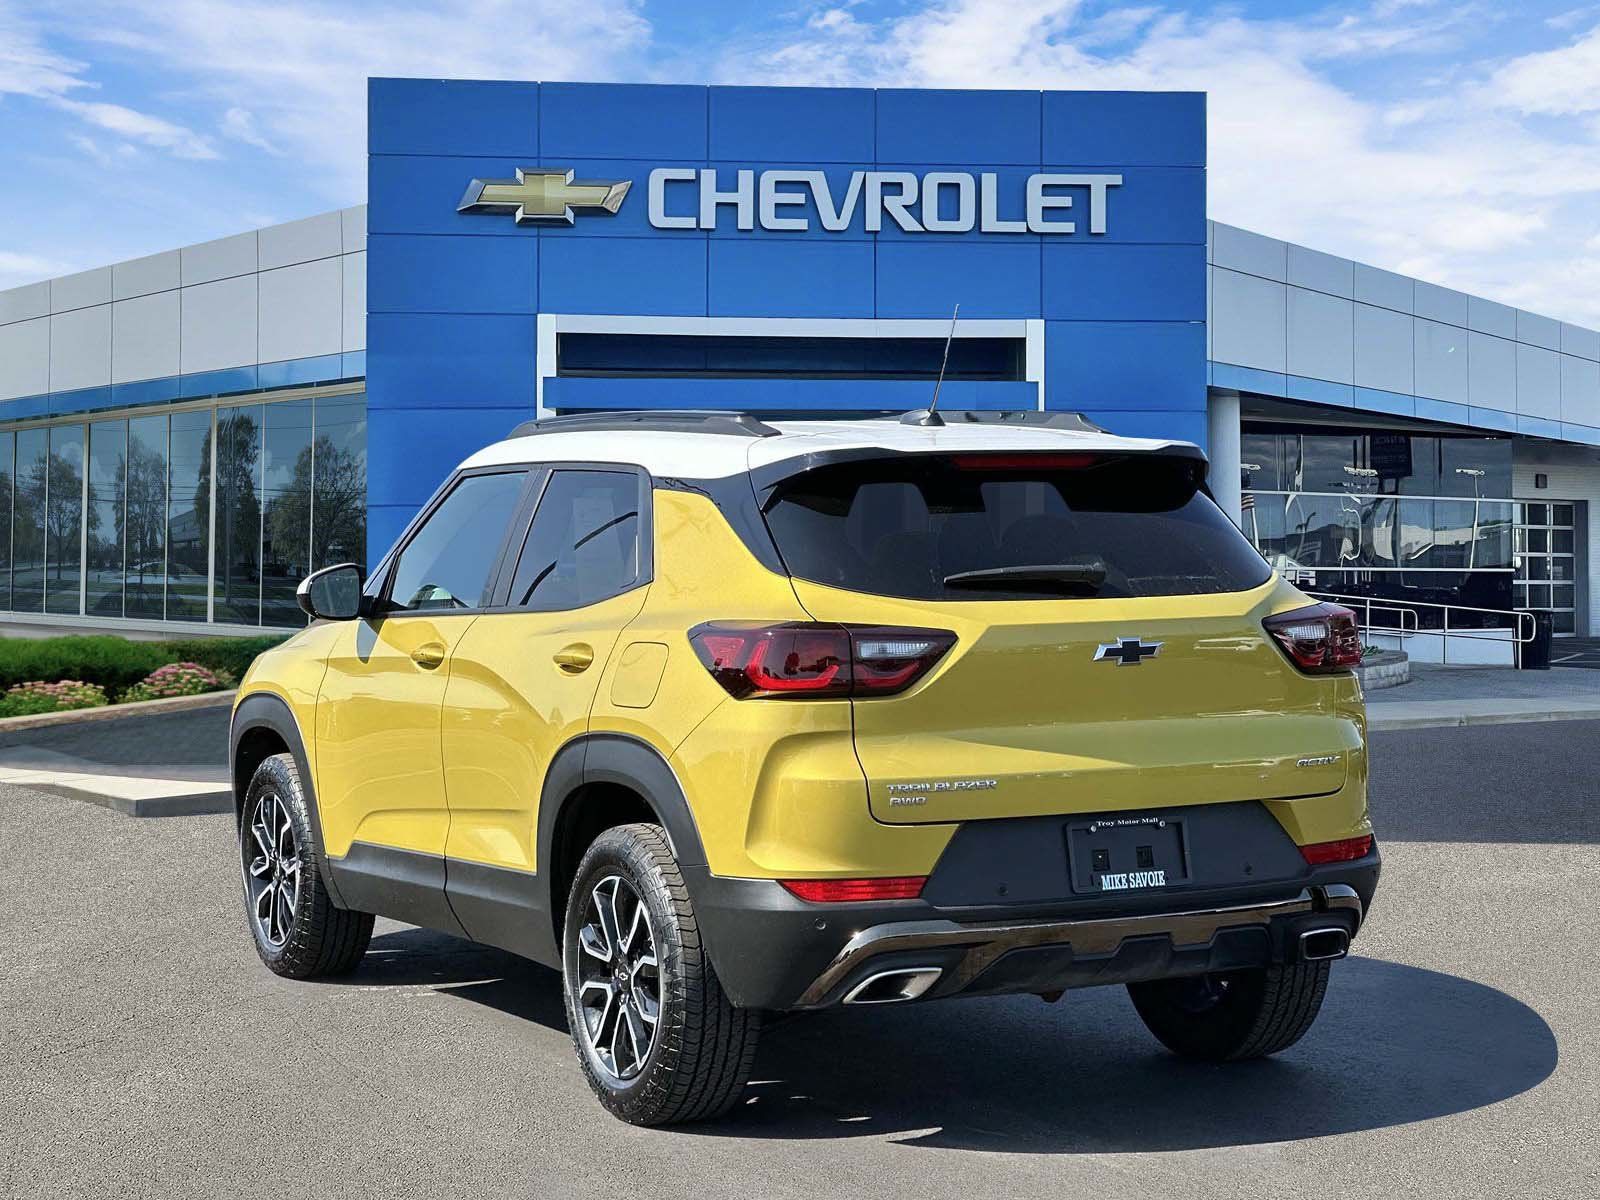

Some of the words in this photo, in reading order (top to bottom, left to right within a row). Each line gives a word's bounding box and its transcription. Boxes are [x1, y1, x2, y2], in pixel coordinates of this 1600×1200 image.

[648, 167, 1123, 235] CHEVROLET
[886, 778, 998, 795] TRAILBLAZER
[1117, 818, 1140, 826] Motor
[1141, 816, 1159, 825] Mall
[1100, 873, 1128, 891] MIKE
[1128, 870, 1166, 889] SAVOIE
